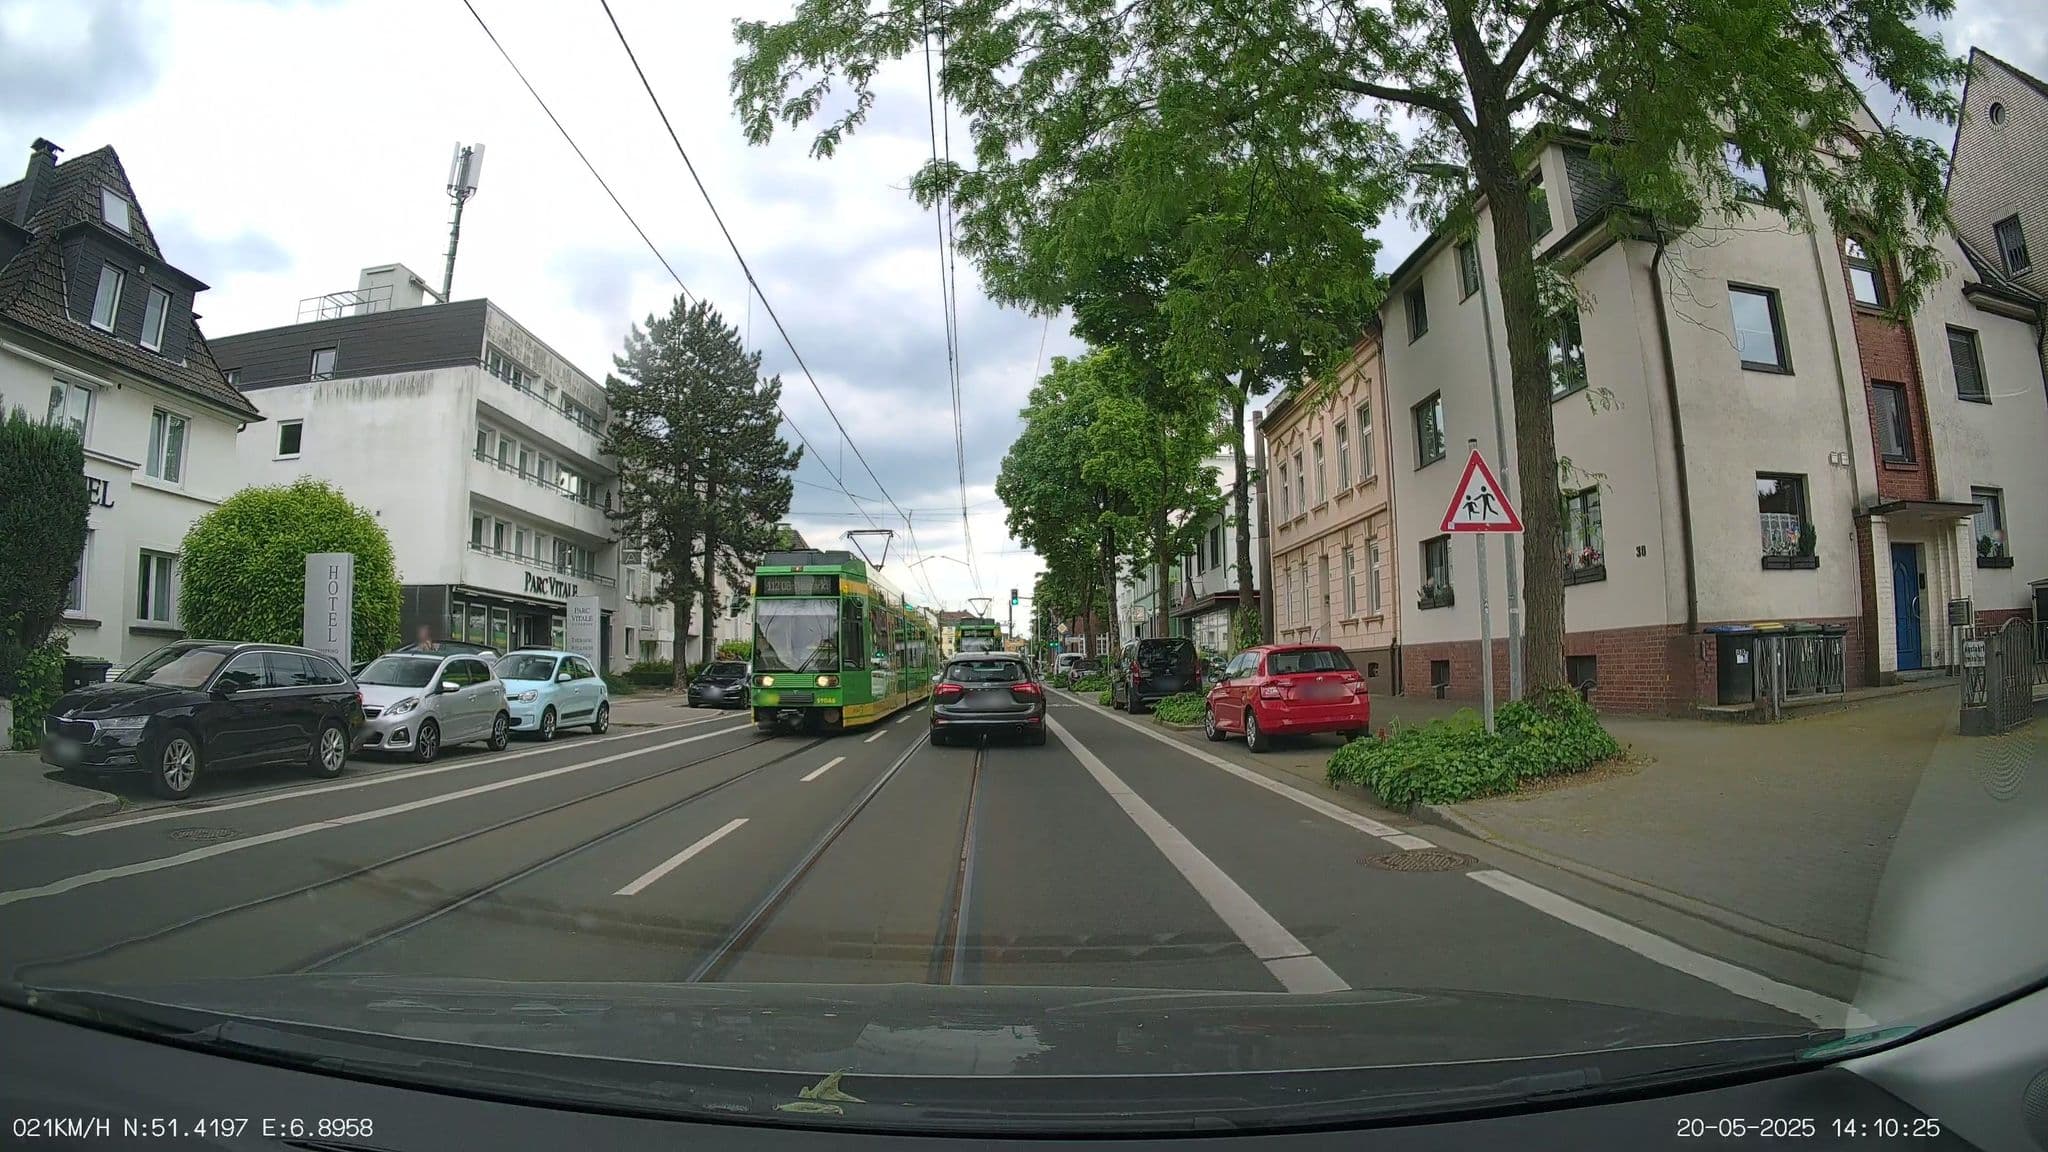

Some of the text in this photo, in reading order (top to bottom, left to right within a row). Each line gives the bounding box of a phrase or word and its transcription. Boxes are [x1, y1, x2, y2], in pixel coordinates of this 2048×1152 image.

[85, 474, 115, 508] EL
[1636, 545, 1647, 557] 30
[524, 571, 549, 595] PARC
[328, 565, 339, 643] HOTEL
